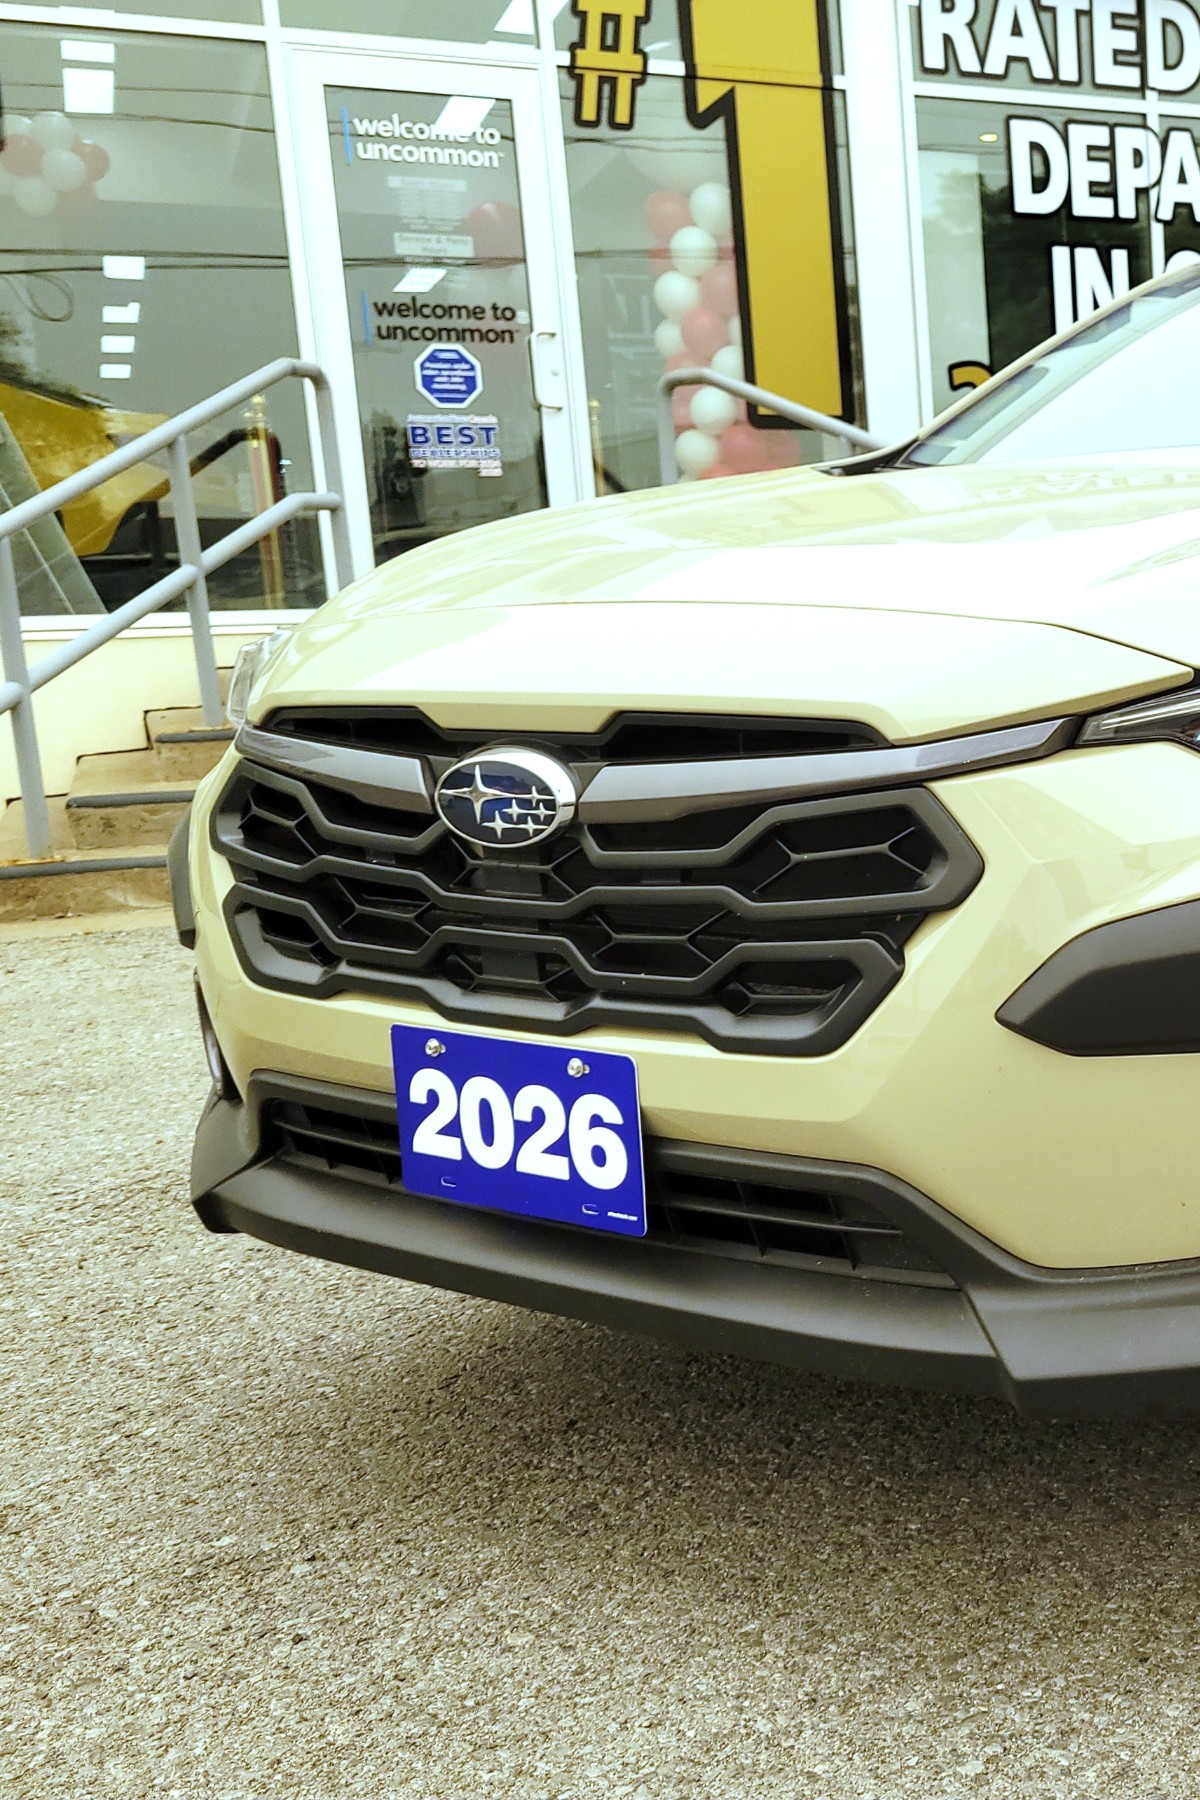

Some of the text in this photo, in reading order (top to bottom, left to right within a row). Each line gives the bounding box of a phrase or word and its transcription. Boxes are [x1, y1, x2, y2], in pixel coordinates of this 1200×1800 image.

[475, 127, 501, 145] to
[356, 142, 499, 168] uncommon
[1051, 245, 1130, 335] IN
[373, 296, 516, 321] welcome to
[377, 324, 516, 344] uncommon
[409, 424, 499, 446] BEST
[409, 1067, 628, 1190] 2026
